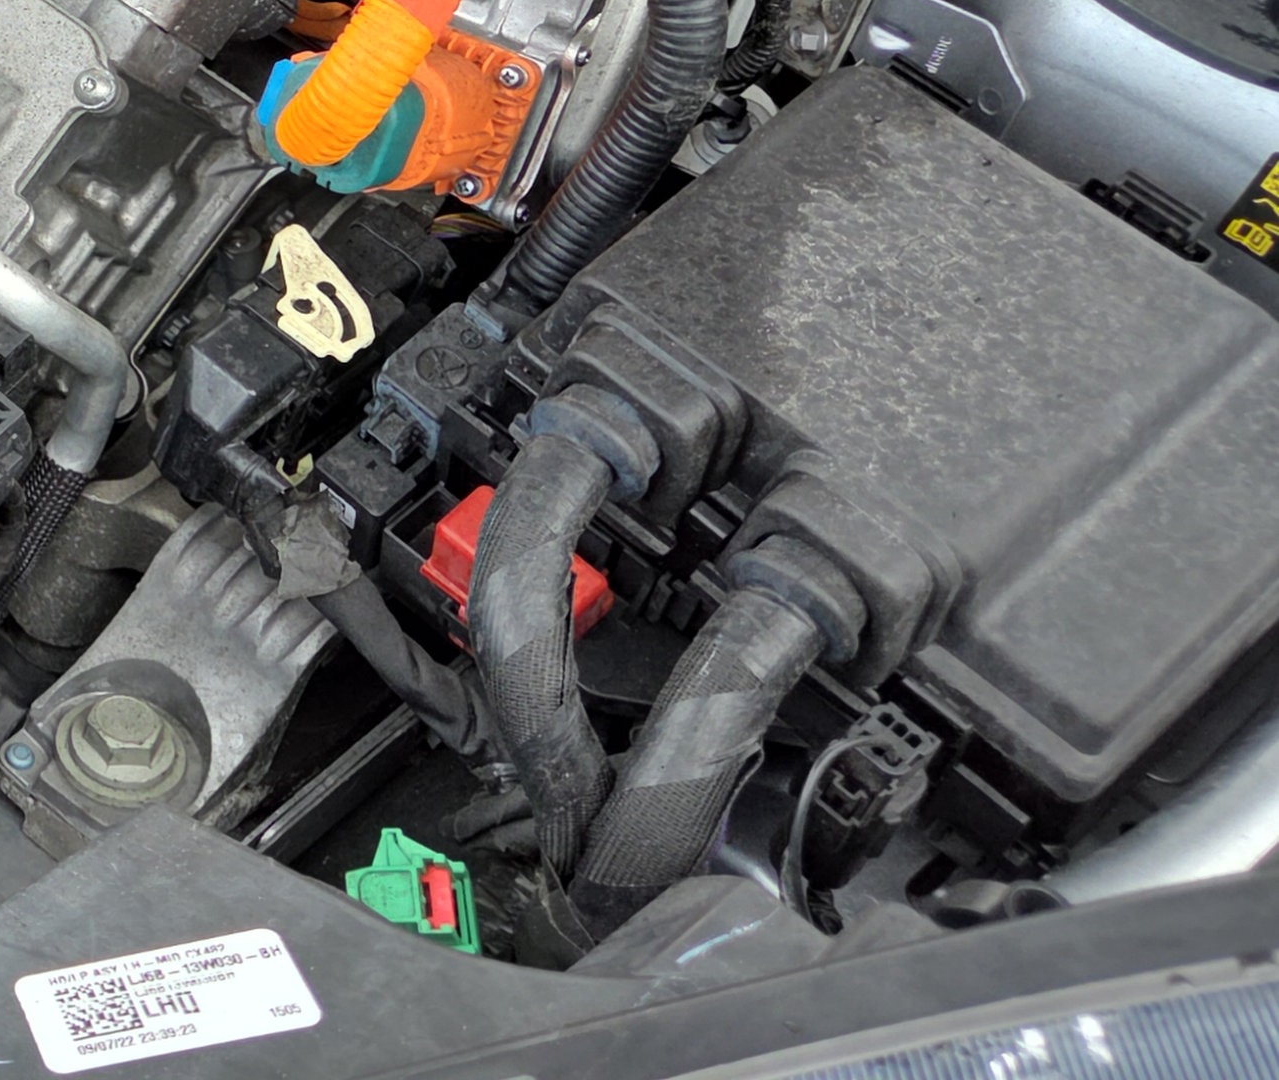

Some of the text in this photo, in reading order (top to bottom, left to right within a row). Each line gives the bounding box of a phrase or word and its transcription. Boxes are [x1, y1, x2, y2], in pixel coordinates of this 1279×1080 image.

[127, 969, 166, 986] LJ6B
[260, 944, 284, 960] BH
[268, 1003, 303, 1020] 1505
[77, 1023, 198, 1056] 09/07/22 23:39:23
